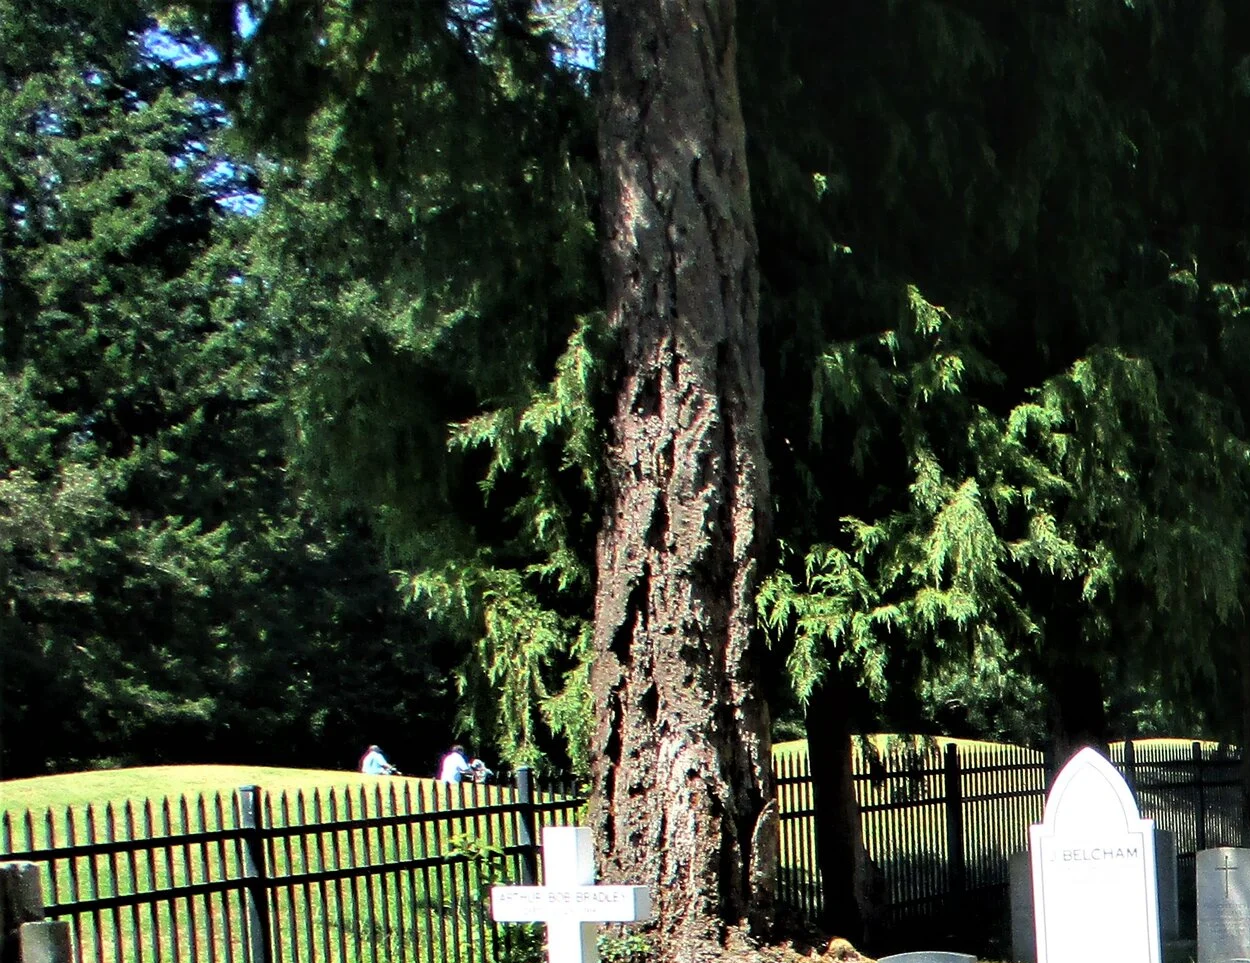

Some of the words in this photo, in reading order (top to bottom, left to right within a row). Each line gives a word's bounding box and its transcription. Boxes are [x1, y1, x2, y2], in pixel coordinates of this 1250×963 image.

[1062, 847, 1139, 862] BELCHAM
[548, 891, 570, 903] BOB
[576, 890, 625, 903] BRADLEY
